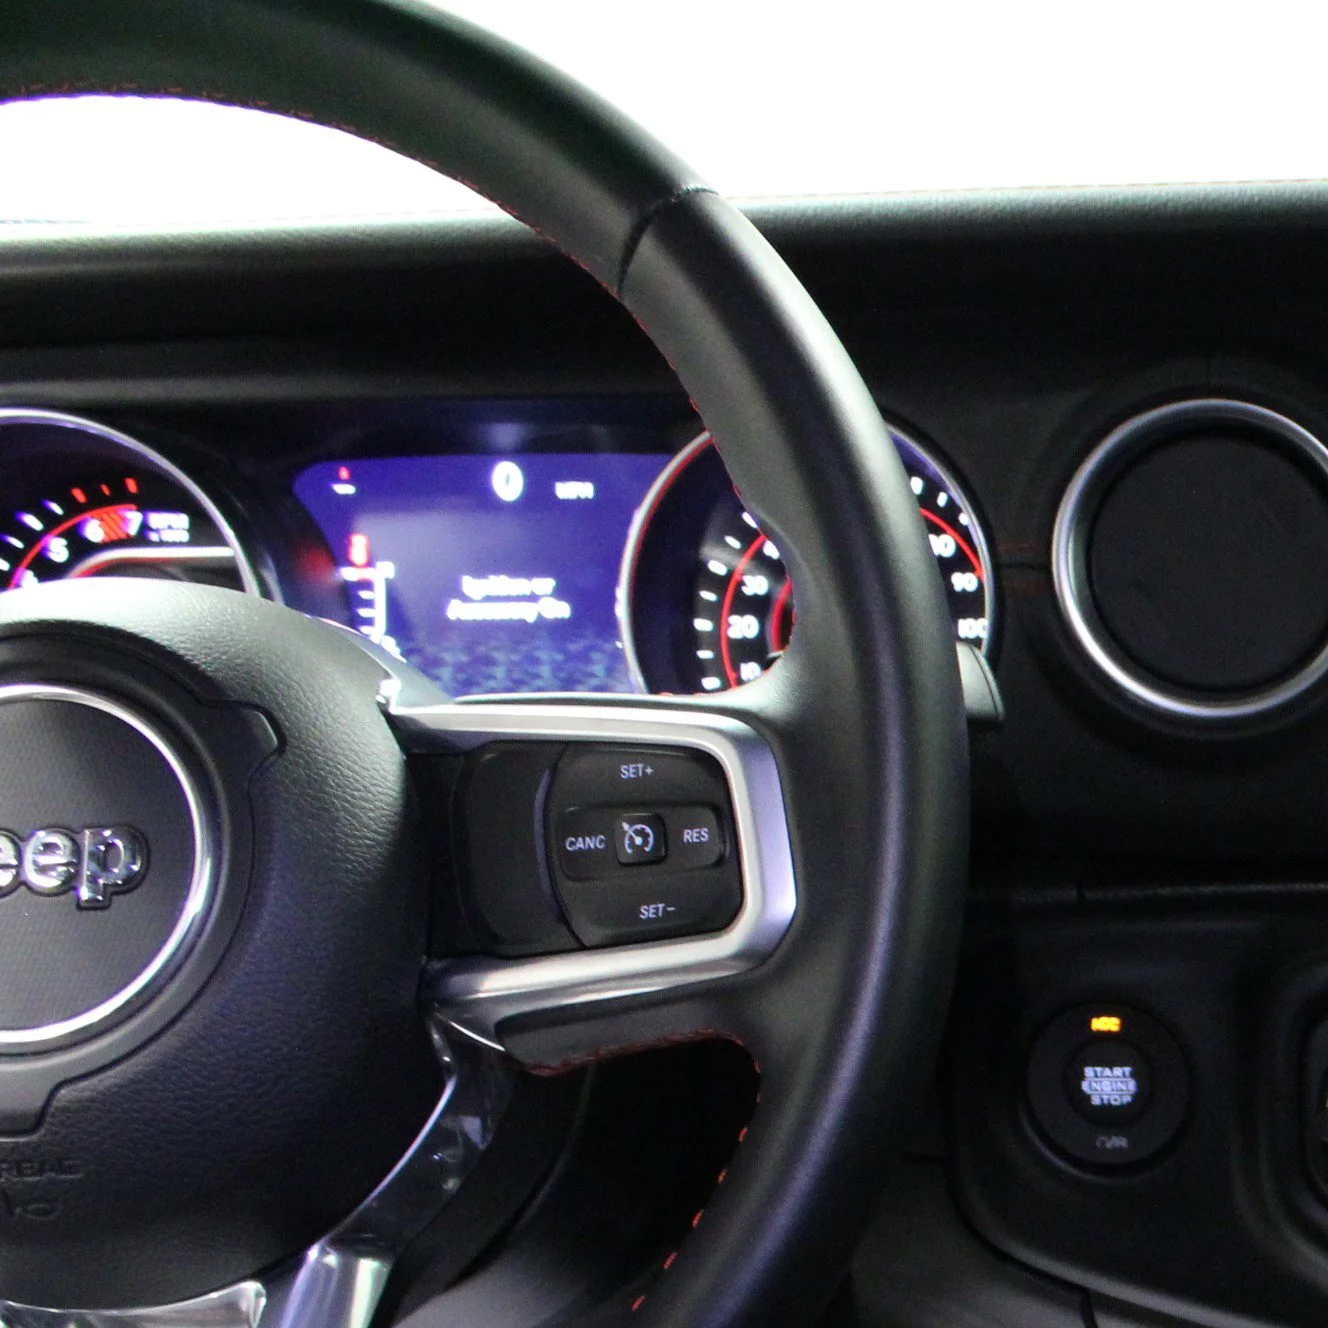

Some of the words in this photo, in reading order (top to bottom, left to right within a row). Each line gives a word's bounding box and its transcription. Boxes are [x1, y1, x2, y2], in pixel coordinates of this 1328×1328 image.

[83, 518, 105, 543] 6
[121, 510, 143, 536] 7
[46, 537, 69, 563] 5
[728, 615, 759, 639] 20
[565, 835, 605, 851] CANC
[683, 828, 709, 843] RES
[1084, 1067, 1132, 1078] START
[1081, 1079, 1137, 1095] ENGINE
[1091, 1095, 1132, 1106] STOP
